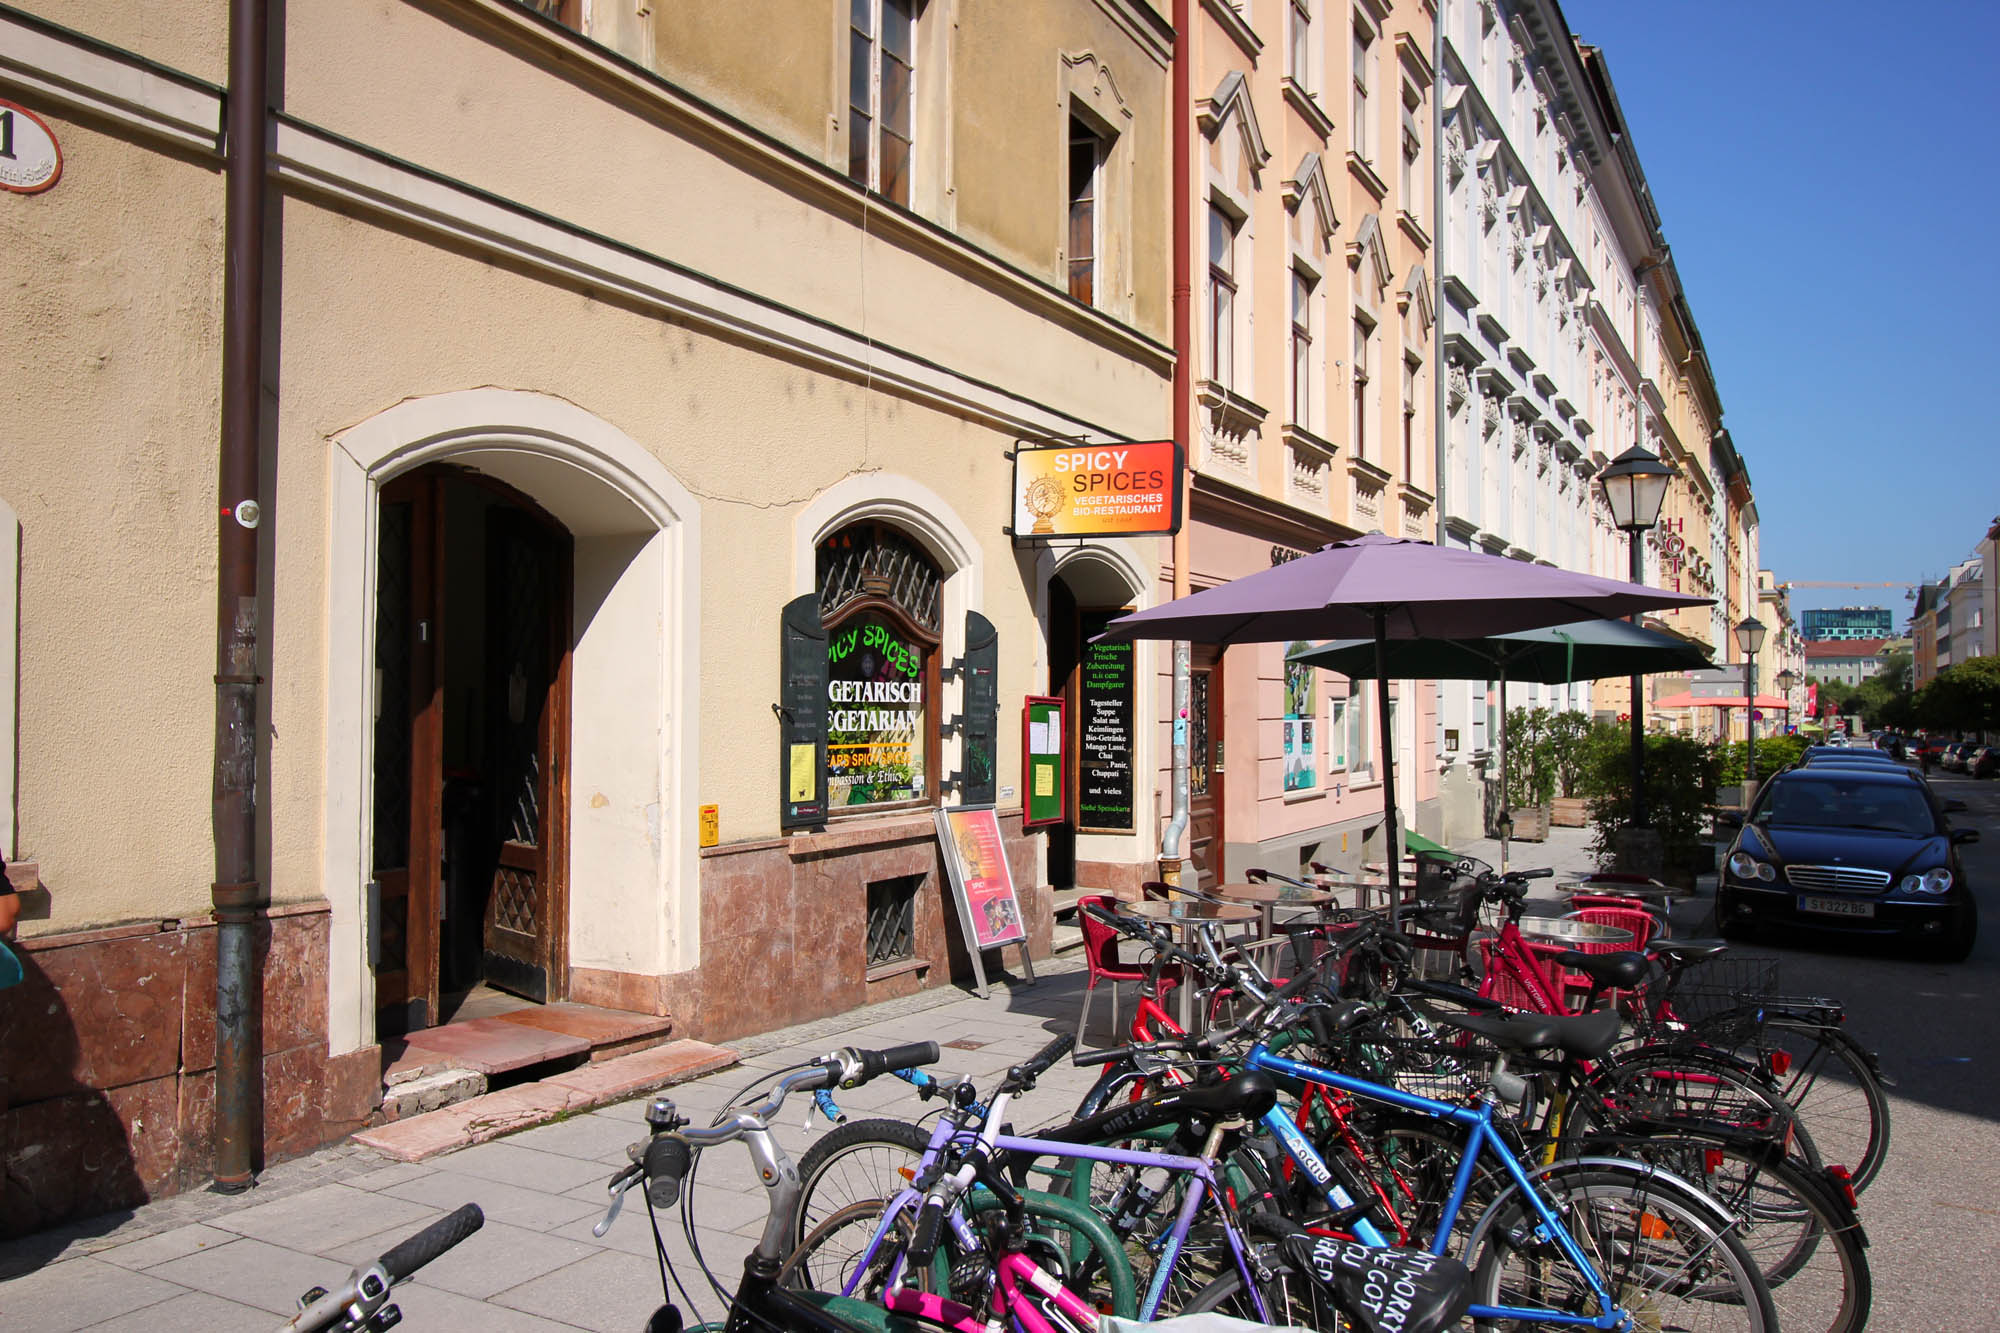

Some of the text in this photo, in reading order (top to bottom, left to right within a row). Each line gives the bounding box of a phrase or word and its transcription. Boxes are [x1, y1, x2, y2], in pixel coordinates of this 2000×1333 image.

[1054, 451, 1129, 472] SPICY
[1073, 470, 1164, 492] SPICES
[1074, 493, 1164, 505] VEGETARISCHES
[1073, 504, 1163, 516] BIO-RESTAURANT
[828, 625, 919, 678] ICY SPICES
[1094, 644, 1131, 653] Vegetarisch
[1086, 680, 1126, 690] Dampfgarer
[828, 680, 922, 703] GETARISCH
[1089, 699, 1123, 708] Tagesteller
[1096, 708, 1116, 717] Suppe
[827, 709, 918, 732] EGETARIAN
[1092, 716, 1120, 724] Salat mit
[1088, 725, 1124, 735] Keimlingen
[1085, 734, 1127, 742] Bio-Getränke
[1085, 743, 1107, 752] Mango
[1098, 752, 1113, 760] Chai
[1103, 787, 1122, 795] vieles
[1523, 978, 1548, 1010] VICTORIA
[1294, 1063, 1324, 1075] CITY
[1360, 1268, 1389, 1315] GOT
[1378, 1269, 1426, 1333] WORRY
